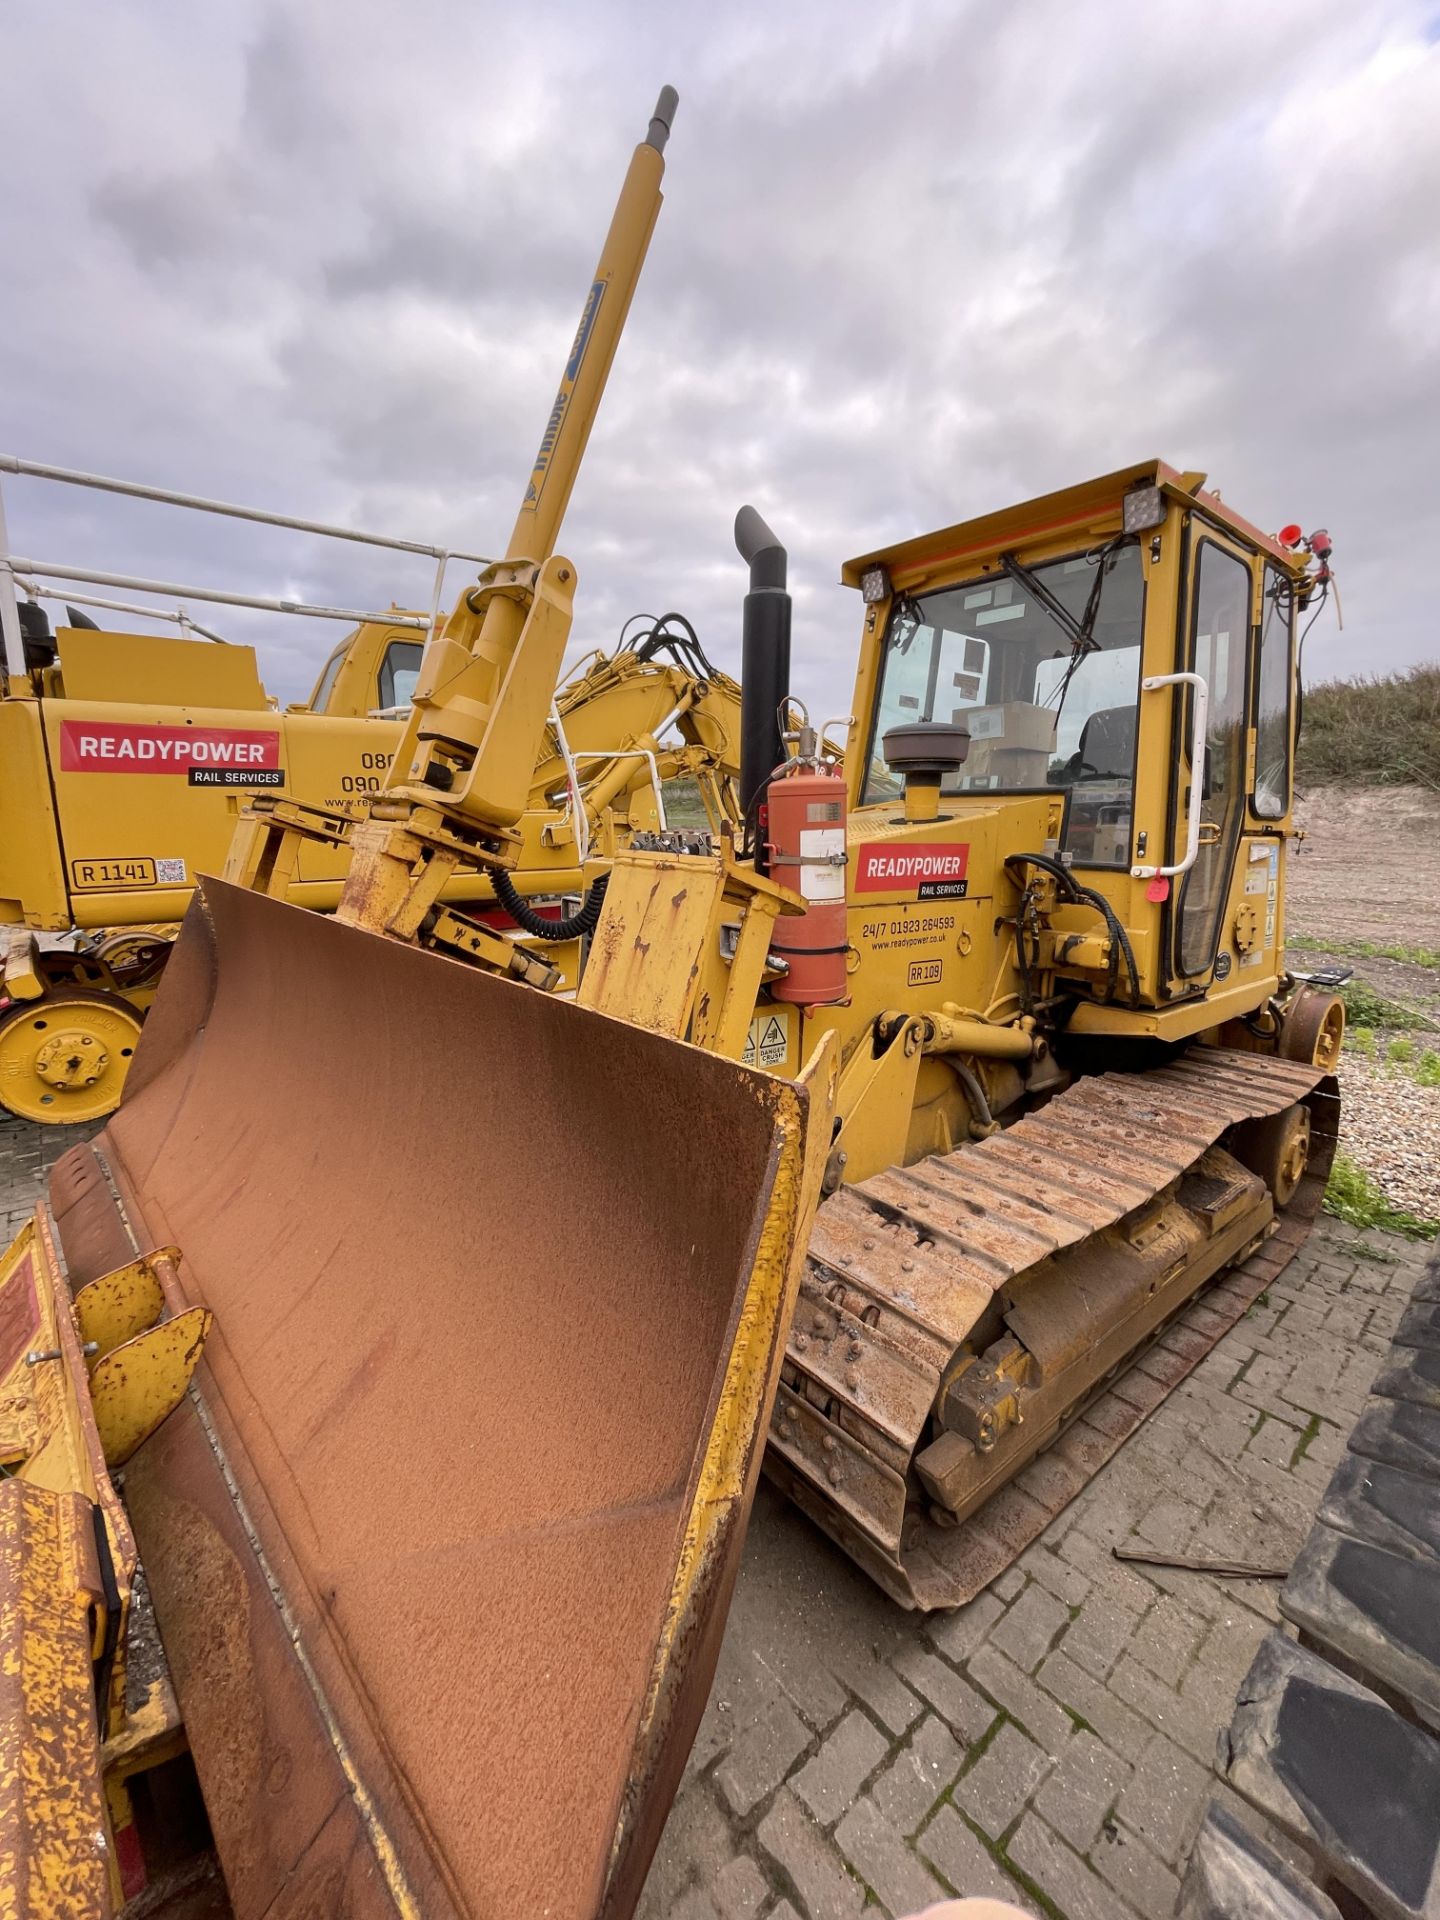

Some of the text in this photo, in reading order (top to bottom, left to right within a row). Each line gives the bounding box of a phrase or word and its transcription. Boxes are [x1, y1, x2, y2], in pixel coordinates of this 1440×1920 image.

[80, 736, 265, 763] READYPOWER
[194, 771, 279, 783] RAIL SERVICES
[82, 864, 149, 882] R 1141
[867, 856, 961, 878] READYPOWER
[921, 884, 965, 896] RAIL SERVICES
[862, 916, 955, 939] 24/7 01923 264593
[871, 933, 946, 951] www.readypower.co.uk
[910, 965, 939, 980] RR 109
[762, 1053, 783, 1062] CRUSH
